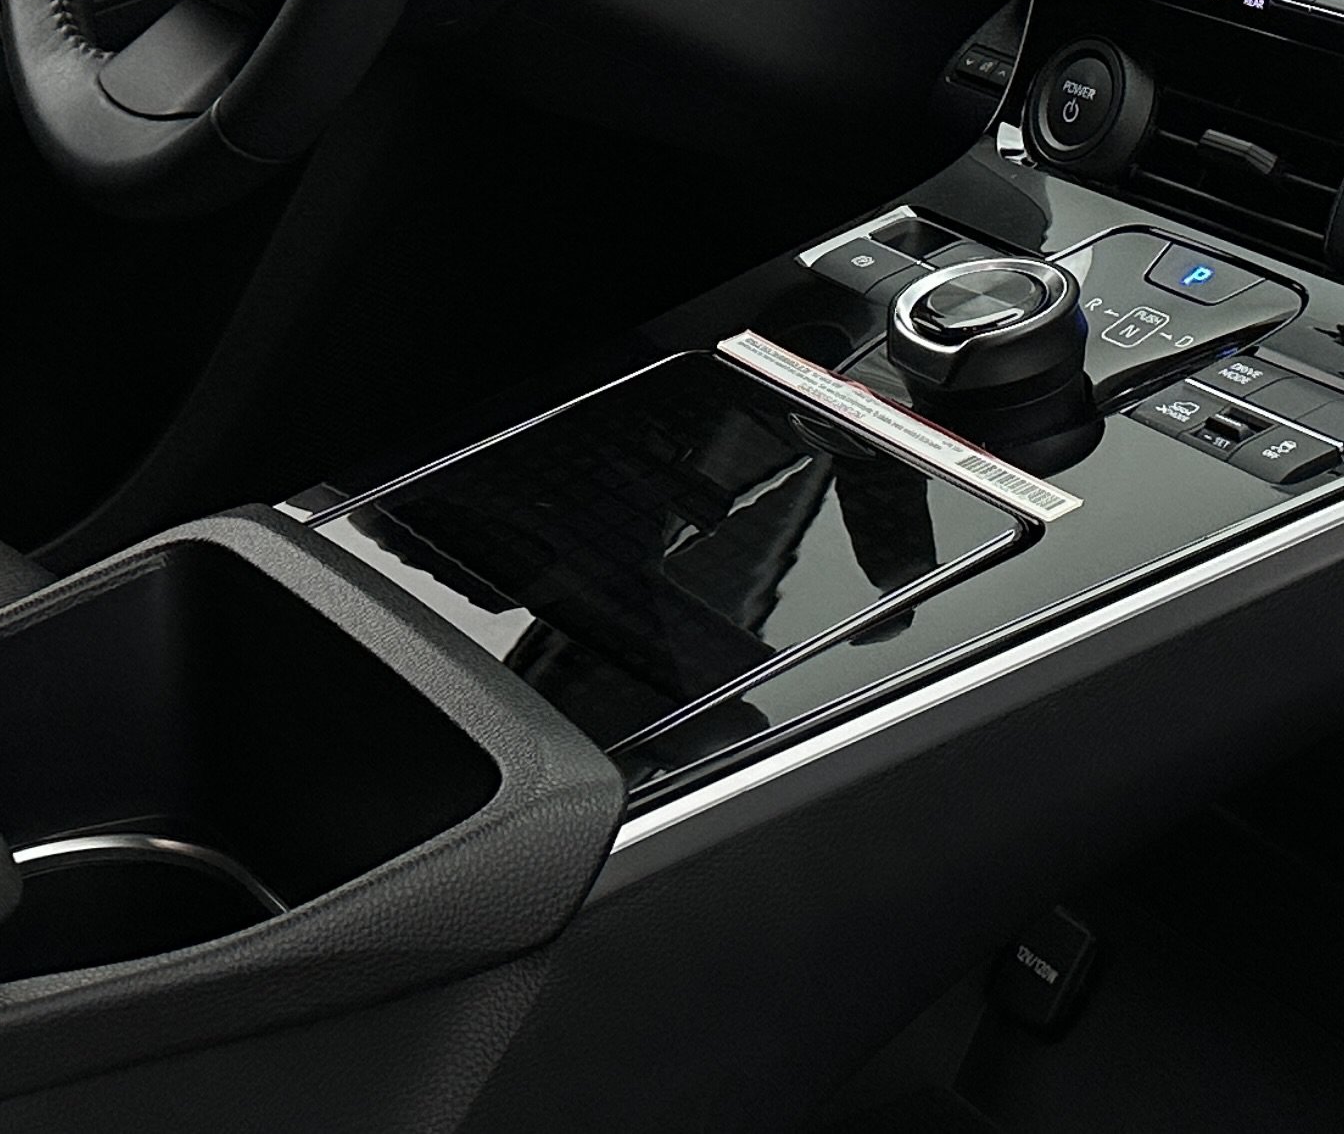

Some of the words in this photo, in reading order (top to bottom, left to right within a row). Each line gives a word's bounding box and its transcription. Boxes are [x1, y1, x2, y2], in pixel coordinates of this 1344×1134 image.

[1062, 79, 1097, 101] POWER
[1181, 266, 1214, 285] P
[1085, 297, 1103, 312] R
[1134, 310, 1164, 326] PUSH
[1119, 324, 1140, 338] N
[1175, 335, 1194, 347] D
[1218, 368, 1252, 385] MODE
[1231, 362, 1264, 379] DRIVE
[1214, 437, 1230, 449] SET
